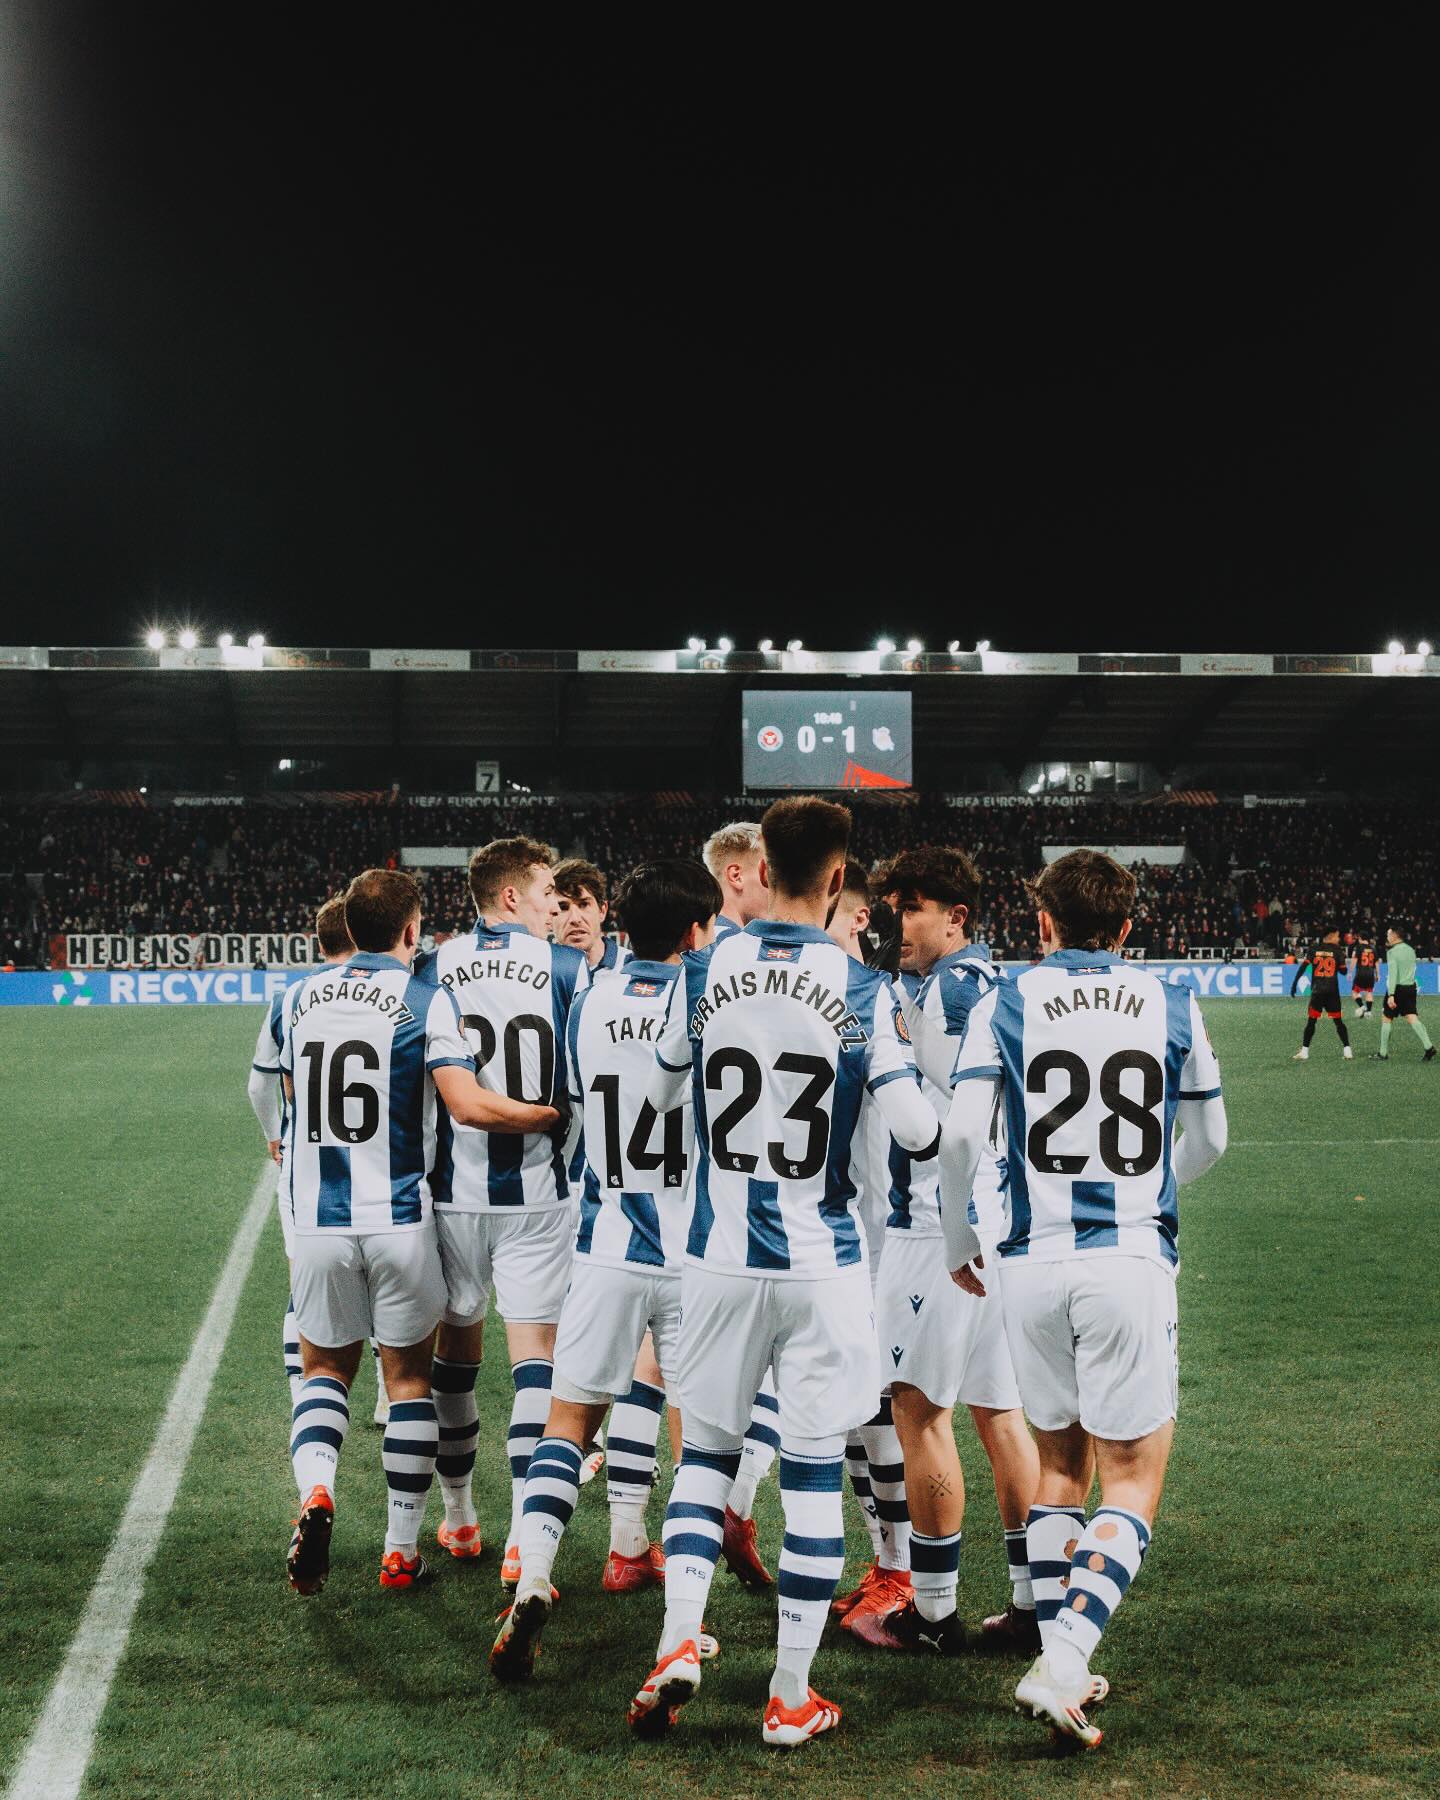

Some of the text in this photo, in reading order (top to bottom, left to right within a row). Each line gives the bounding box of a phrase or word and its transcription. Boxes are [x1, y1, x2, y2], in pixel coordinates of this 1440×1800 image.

[481, 773, 495, 791] 7
[1075, 774, 1086, 792] 8
[69, 936, 190, 966] HEDENS
[441, 960, 550, 992] PACHECO
[1313, 957, 1336, 977] 29
[691, 970, 869, 1053] BRAIS MÉNDEZ
[1043, 985, 1145, 1021] MARÍN
[300, 1040, 380, 1144] 16
[705, 1047, 836, 1180] 23
[1026, 1049, 1164, 1177] 28
[590, 1074, 688, 1189] 14
[316, 1450, 335, 1463] RS
[393, 1499, 415, 1510] RS
[542, 1524, 559, 1540] RS
[685, 1566, 706, 1580] RS
[781, 1609, 802, 1622] RS
